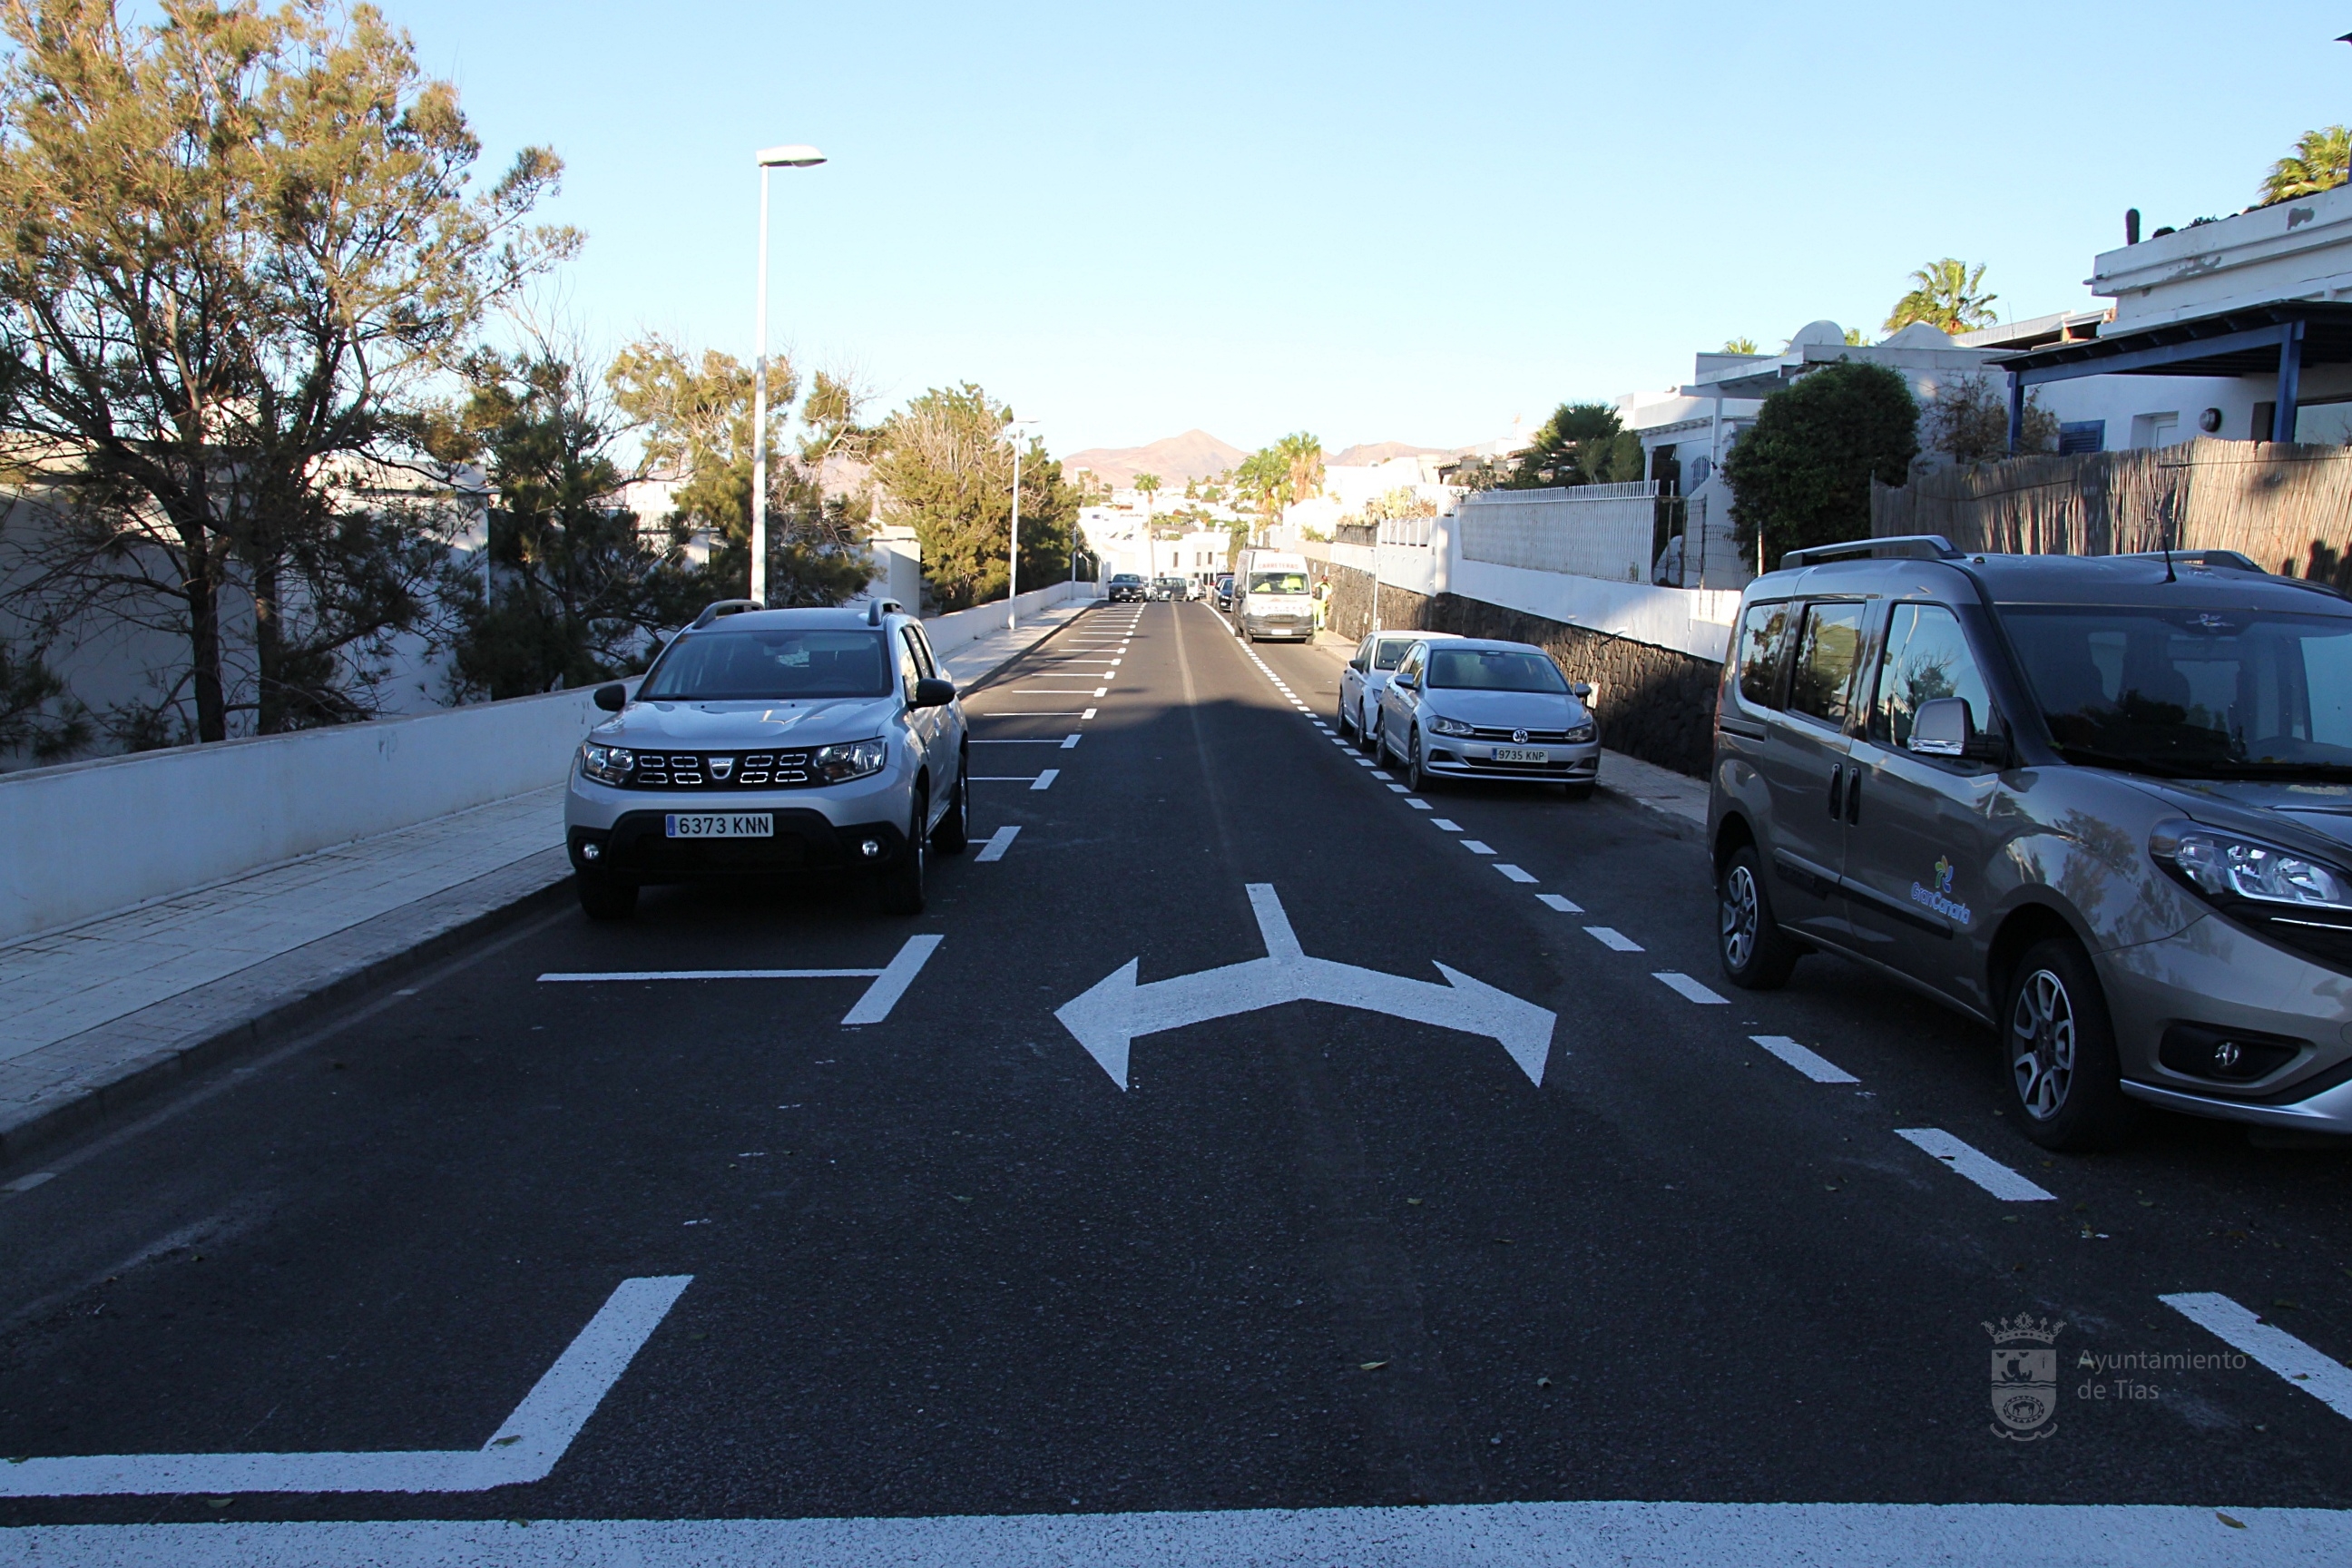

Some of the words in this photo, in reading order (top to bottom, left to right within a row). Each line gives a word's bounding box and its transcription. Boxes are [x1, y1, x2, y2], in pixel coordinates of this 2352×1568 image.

[1499, 750, 1523, 760] 9735
[1525, 751, 1544, 760] KNP
[679, 818, 727, 834] 6373
[732, 817, 769, 834] KNN
